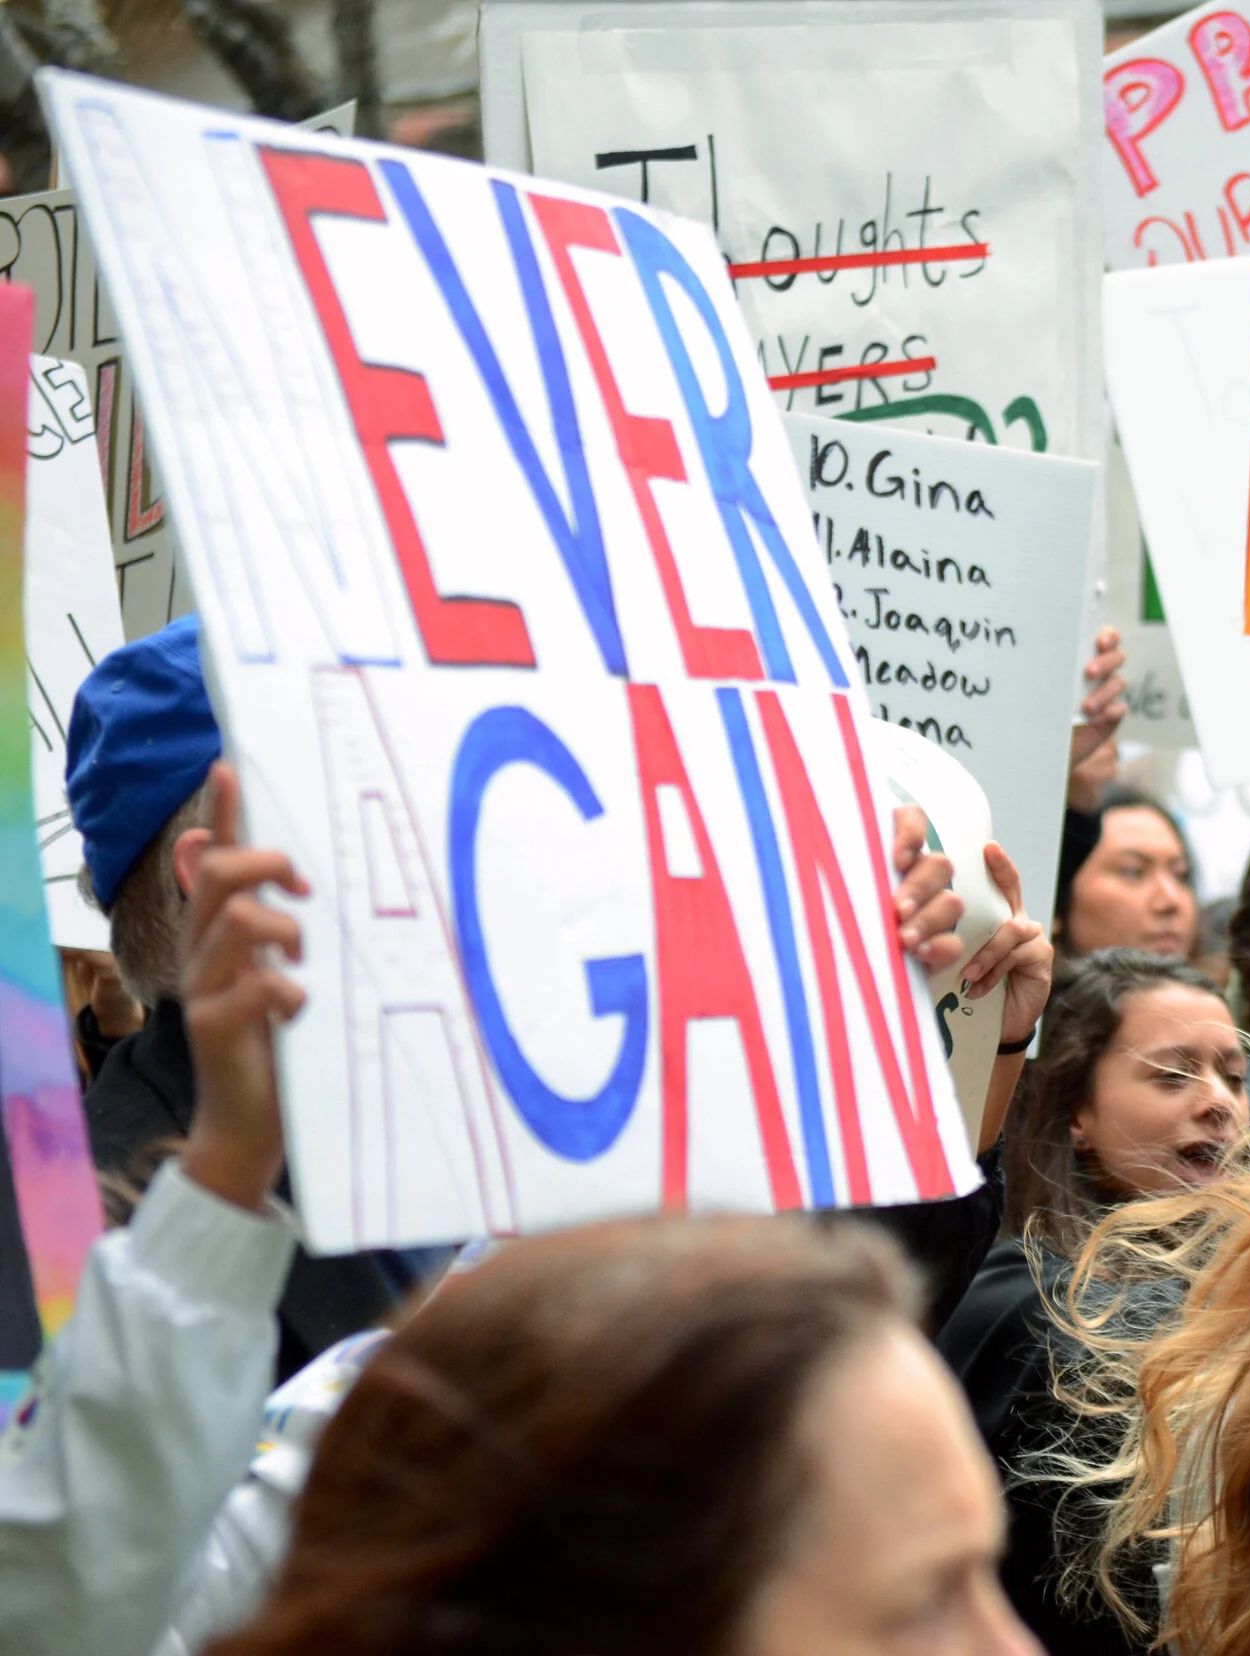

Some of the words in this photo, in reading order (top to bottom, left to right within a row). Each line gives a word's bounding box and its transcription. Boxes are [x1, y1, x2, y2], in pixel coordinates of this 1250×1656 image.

[865, 449, 996, 520] Gina
[848, 525, 991, 588] Alaina
[864, 587, 1017, 654] Joaquin
[310, 664, 957, 1239] AGAIN
